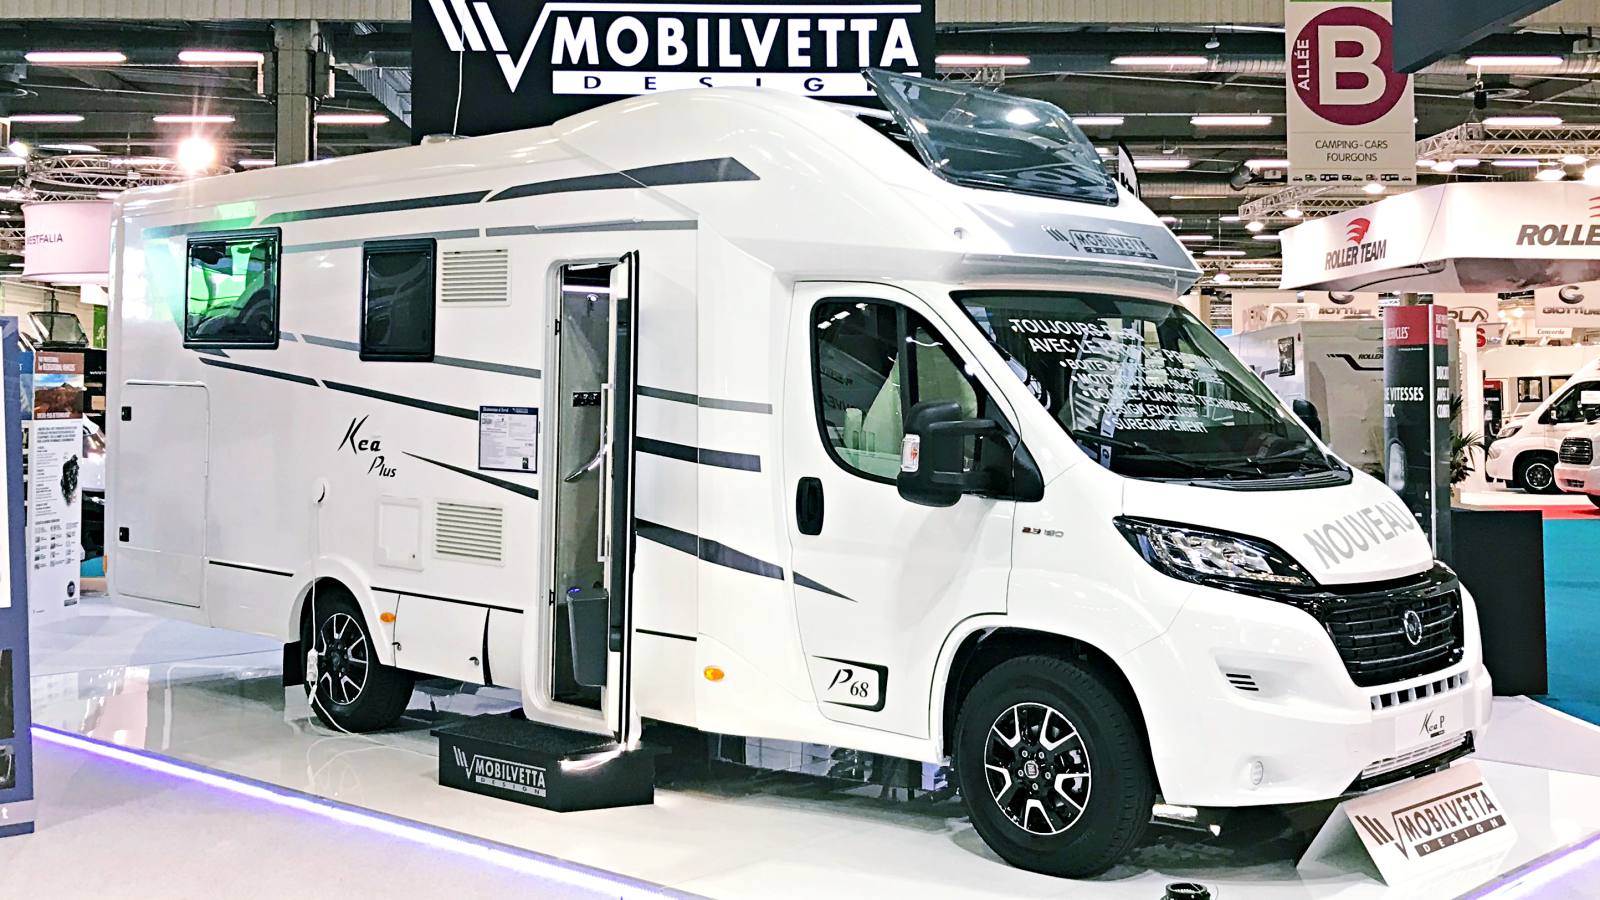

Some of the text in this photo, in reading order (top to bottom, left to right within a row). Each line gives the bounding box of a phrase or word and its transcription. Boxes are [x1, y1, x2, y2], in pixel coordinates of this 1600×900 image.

[551, 16, 919, 67] MOBILVETTA
[1294, 25, 1387, 105] ALLÉE B
[584, 76, 880, 91] DESIG
[1326, 152, 1377, 162] FOURGONS
[1325, 239, 1387, 271] ROLLER TEAM
[1009, 319, 1104, 337] TOUJOURS
[1028, 337, 1076, 353] AVEC
[1065, 359, 1106, 371] BOITE
[1088, 387, 1141, 401] DOULE
[1140, 390, 1200, 405] PLANCHER
[1390, 387, 1424, 401] VITESSES
[1113, 418, 1208, 433] SUREQUIPEMENT
[367, 456, 397, 477] Plus
[1303, 501, 1415, 569] NOUVEAU
[475, 758, 546, 788] MOBILVETTA
[480, 776, 540, 795] DESIGN
[1398, 789, 1498, 842] MOBILVETTA
[1422, 818, 1500, 854] DESIGN
